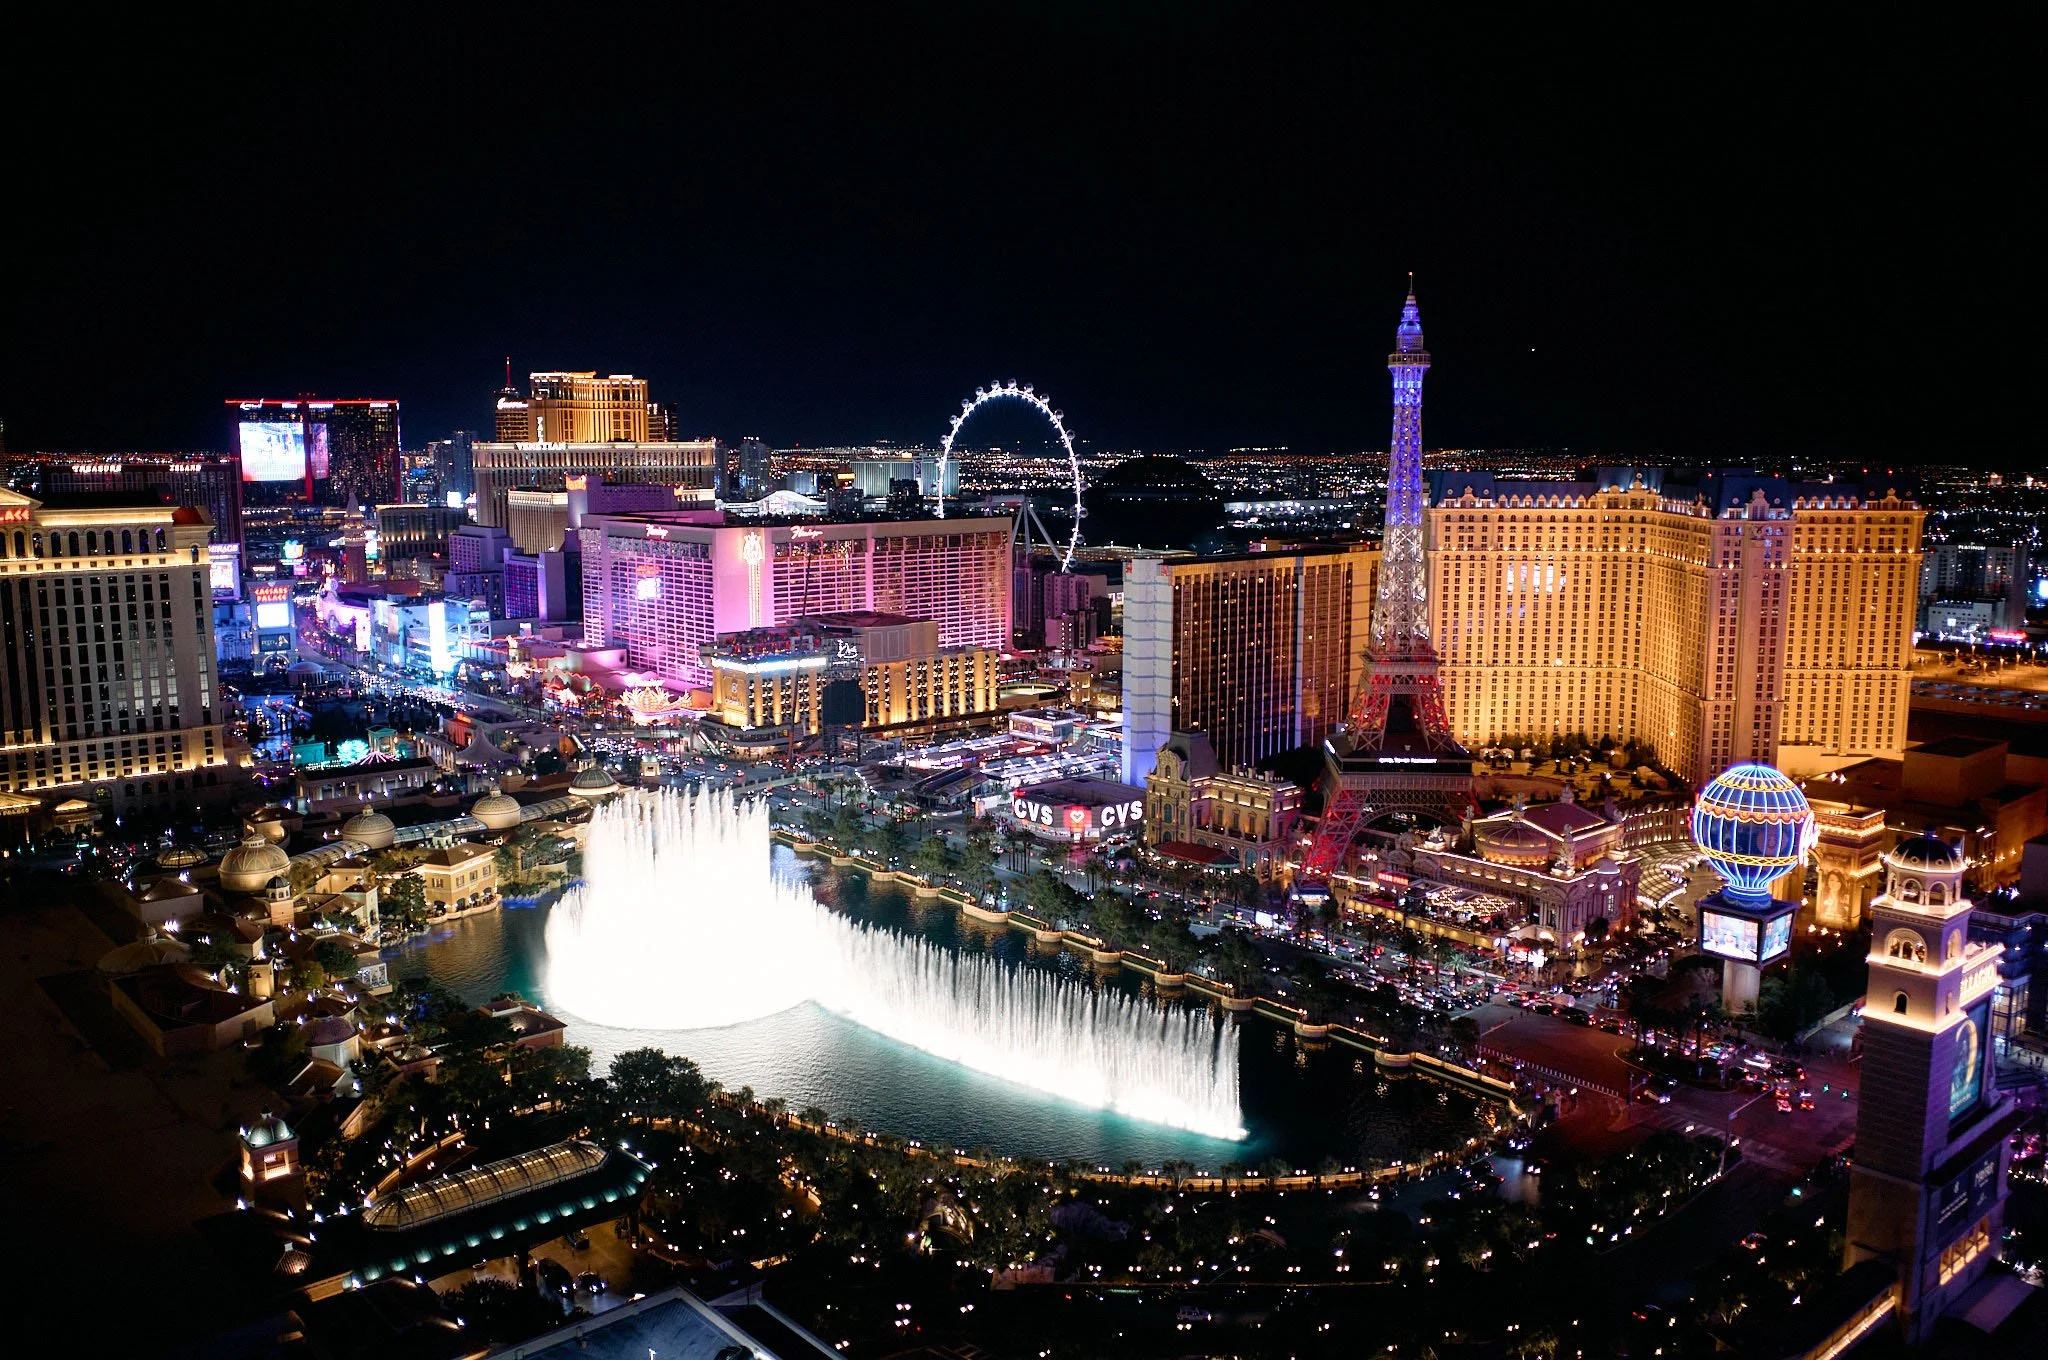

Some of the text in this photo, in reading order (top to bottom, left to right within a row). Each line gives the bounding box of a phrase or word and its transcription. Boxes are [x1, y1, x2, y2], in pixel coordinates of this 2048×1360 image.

[169, 464, 202, 473] ISLAND
[790, 525, 823, 540] Flamingo
[254, 586, 288, 596] CAESARS
[256, 594, 287, 603] PALACE
[1014, 798, 1054, 826] CVS
[1101, 800, 1143, 827] CVS
